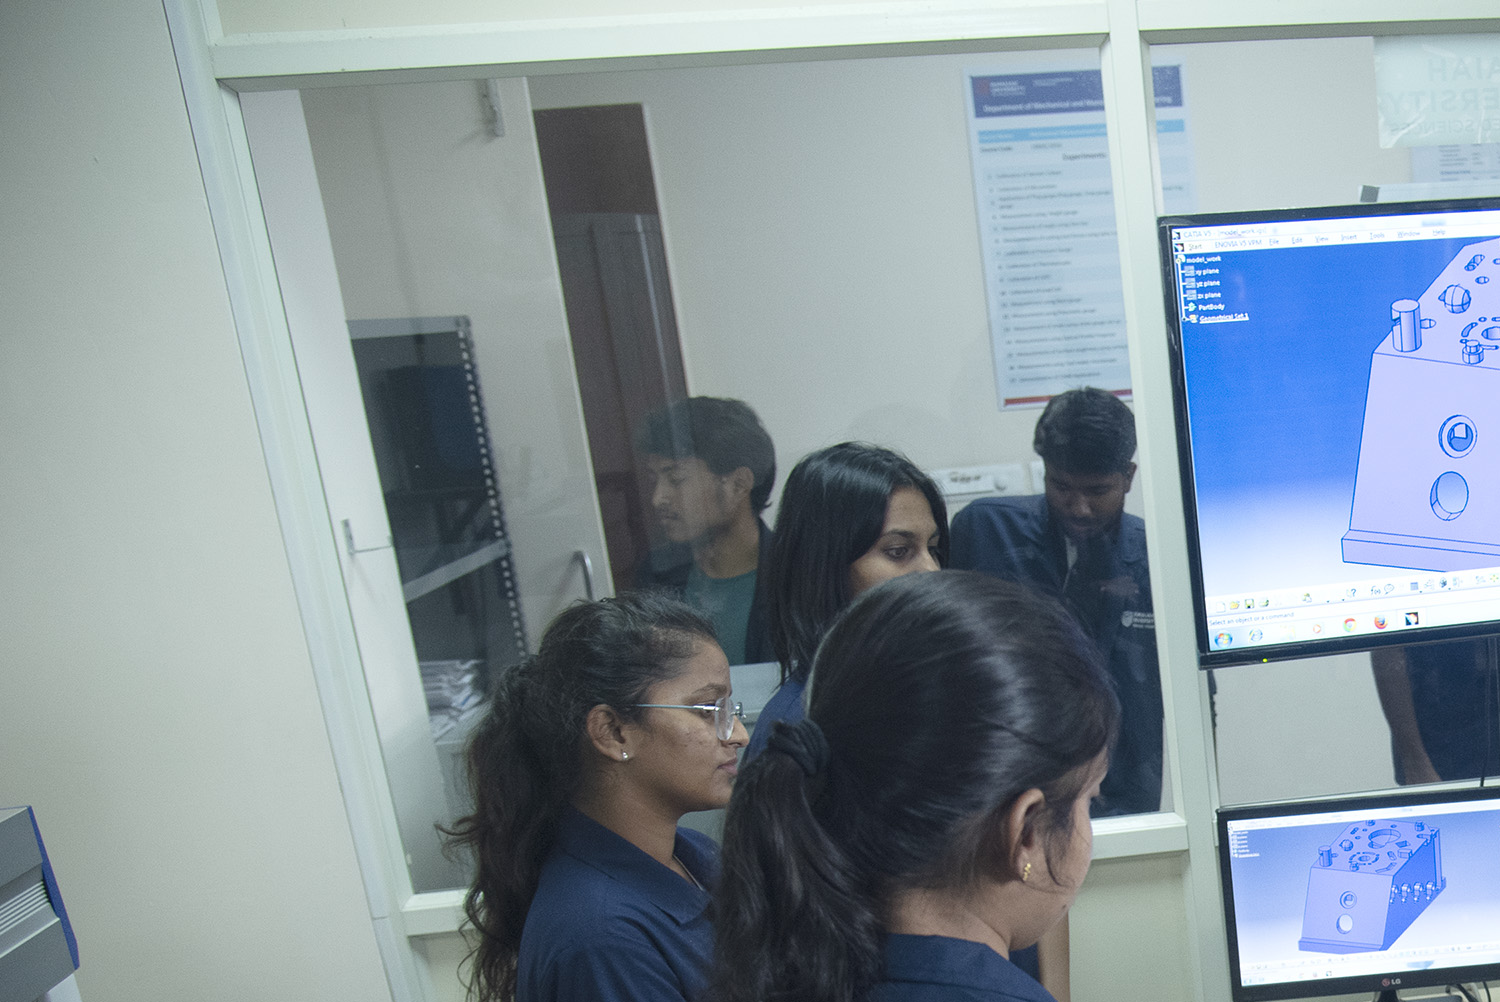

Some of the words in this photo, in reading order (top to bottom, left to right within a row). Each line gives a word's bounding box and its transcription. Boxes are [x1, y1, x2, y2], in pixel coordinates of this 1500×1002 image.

[1292, 236, 1302, 244] Edit
[1370, 232, 1384, 240] Tools
[1398, 230, 1420, 238] Window
[1432, 229, 1446, 237] Help
